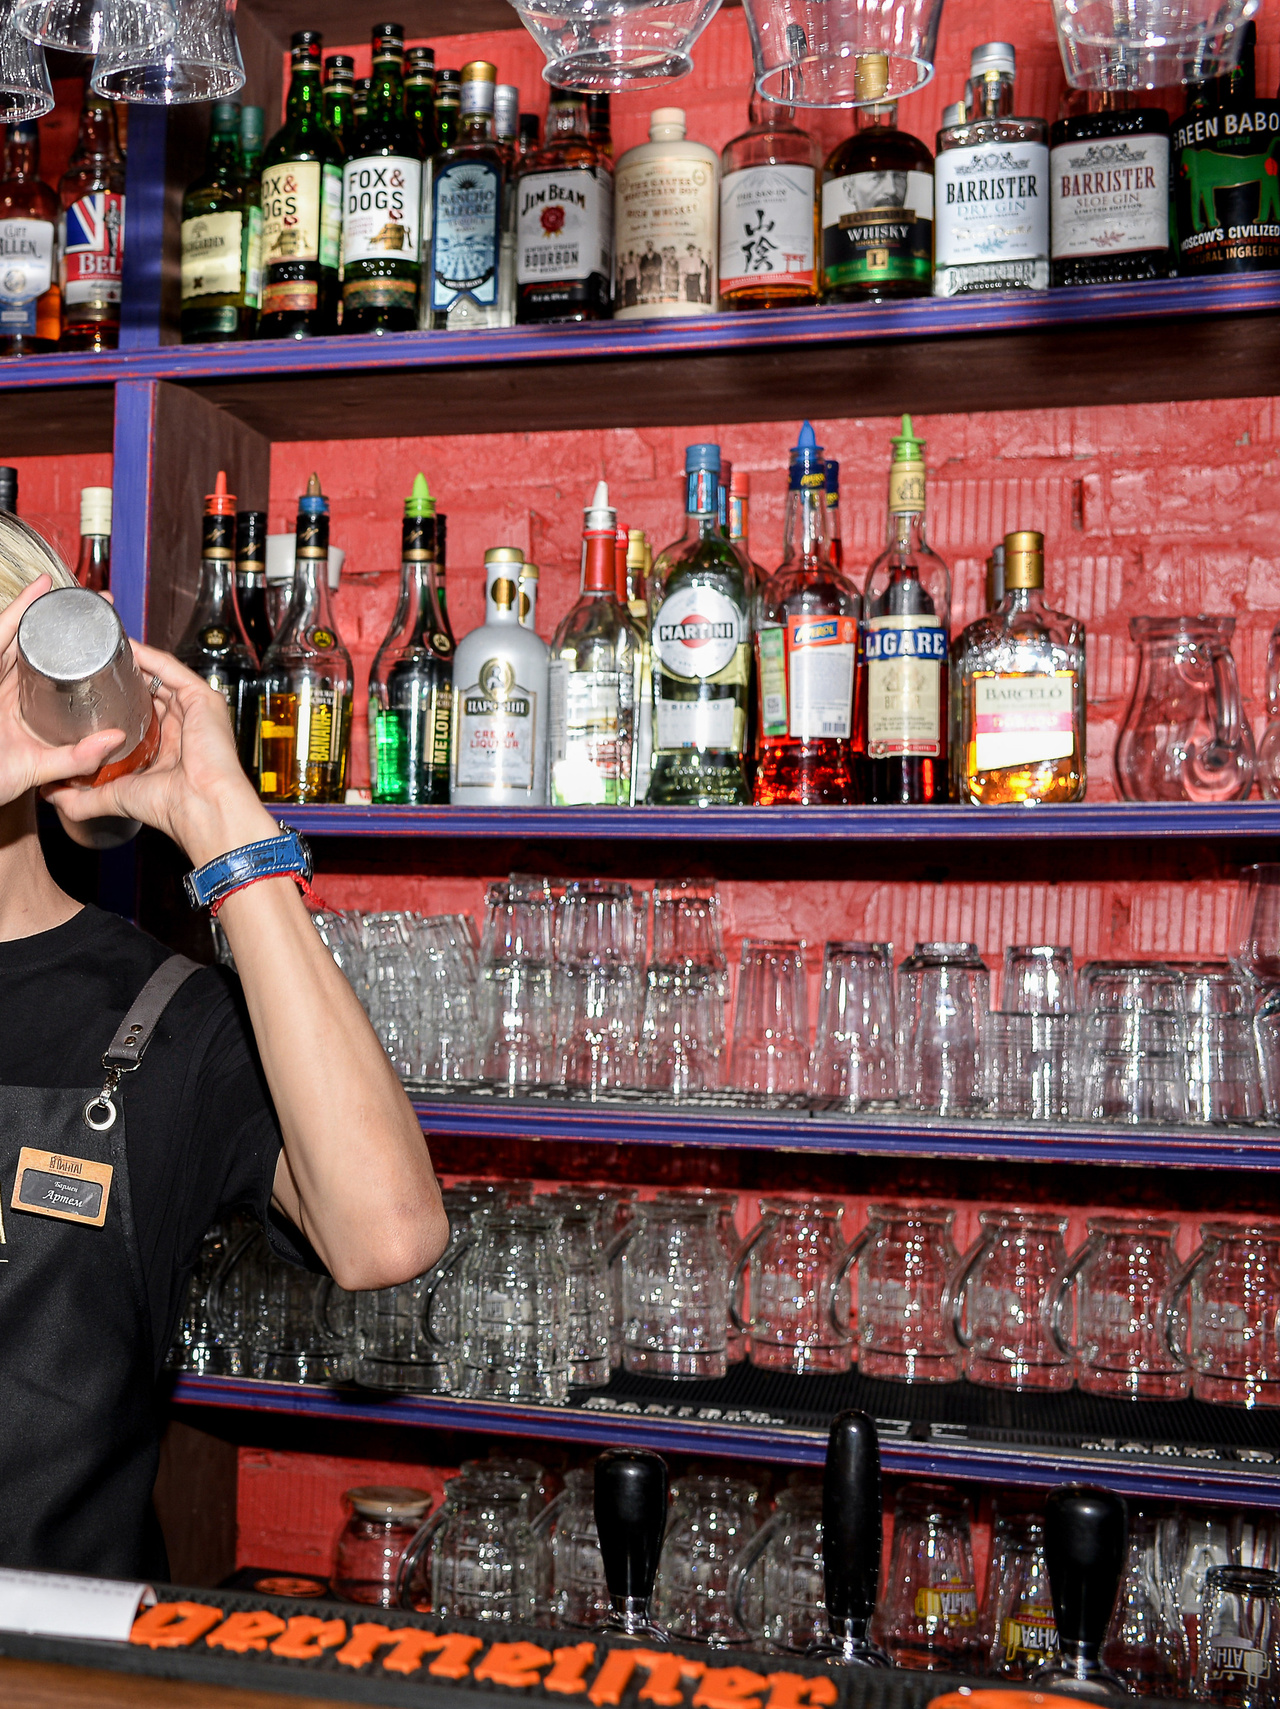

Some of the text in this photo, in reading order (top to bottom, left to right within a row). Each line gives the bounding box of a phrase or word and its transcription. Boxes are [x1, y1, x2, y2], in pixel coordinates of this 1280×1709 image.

[1173, 117, 1218, 150] GREEN
[263, 175, 297, 199] OX &
[349, 168, 404, 191] FOX &
[946, 175, 1038, 204] BARRISTER
[1061, 166, 1156, 198] BARRISTER
[263, 197, 297, 221] OGS
[349, 191, 403, 214] DOGS
[521, 184, 586, 216] JIM BEAM
[957, 203, 988, 217] DRY
[994, 200, 1026, 214] GIN
[1077, 193, 1140, 208] SLOE GIN
[847, 225, 910, 242] WHISKY
[1181, 225, 1280, 250] MOSCOW'S CIVILIZED
[525, 251, 579, 267] BOURBON
[1188, 249, 1223, 264] ATURAL
[660, 622, 733, 641] MARTINI
[794, 623, 836, 643] AEROL
[985, 684, 1063, 702] BARCELÓ
[433, 709, 450, 764] MELON
[474, 730, 515, 739] CREM
[54, 1181, 78, 1193] Бармен
[42, 1190, 83, 1208] Артем
[1020, 1625, 1059, 1651] ИНТА
[129, 1600, 838, 1708] germeister
